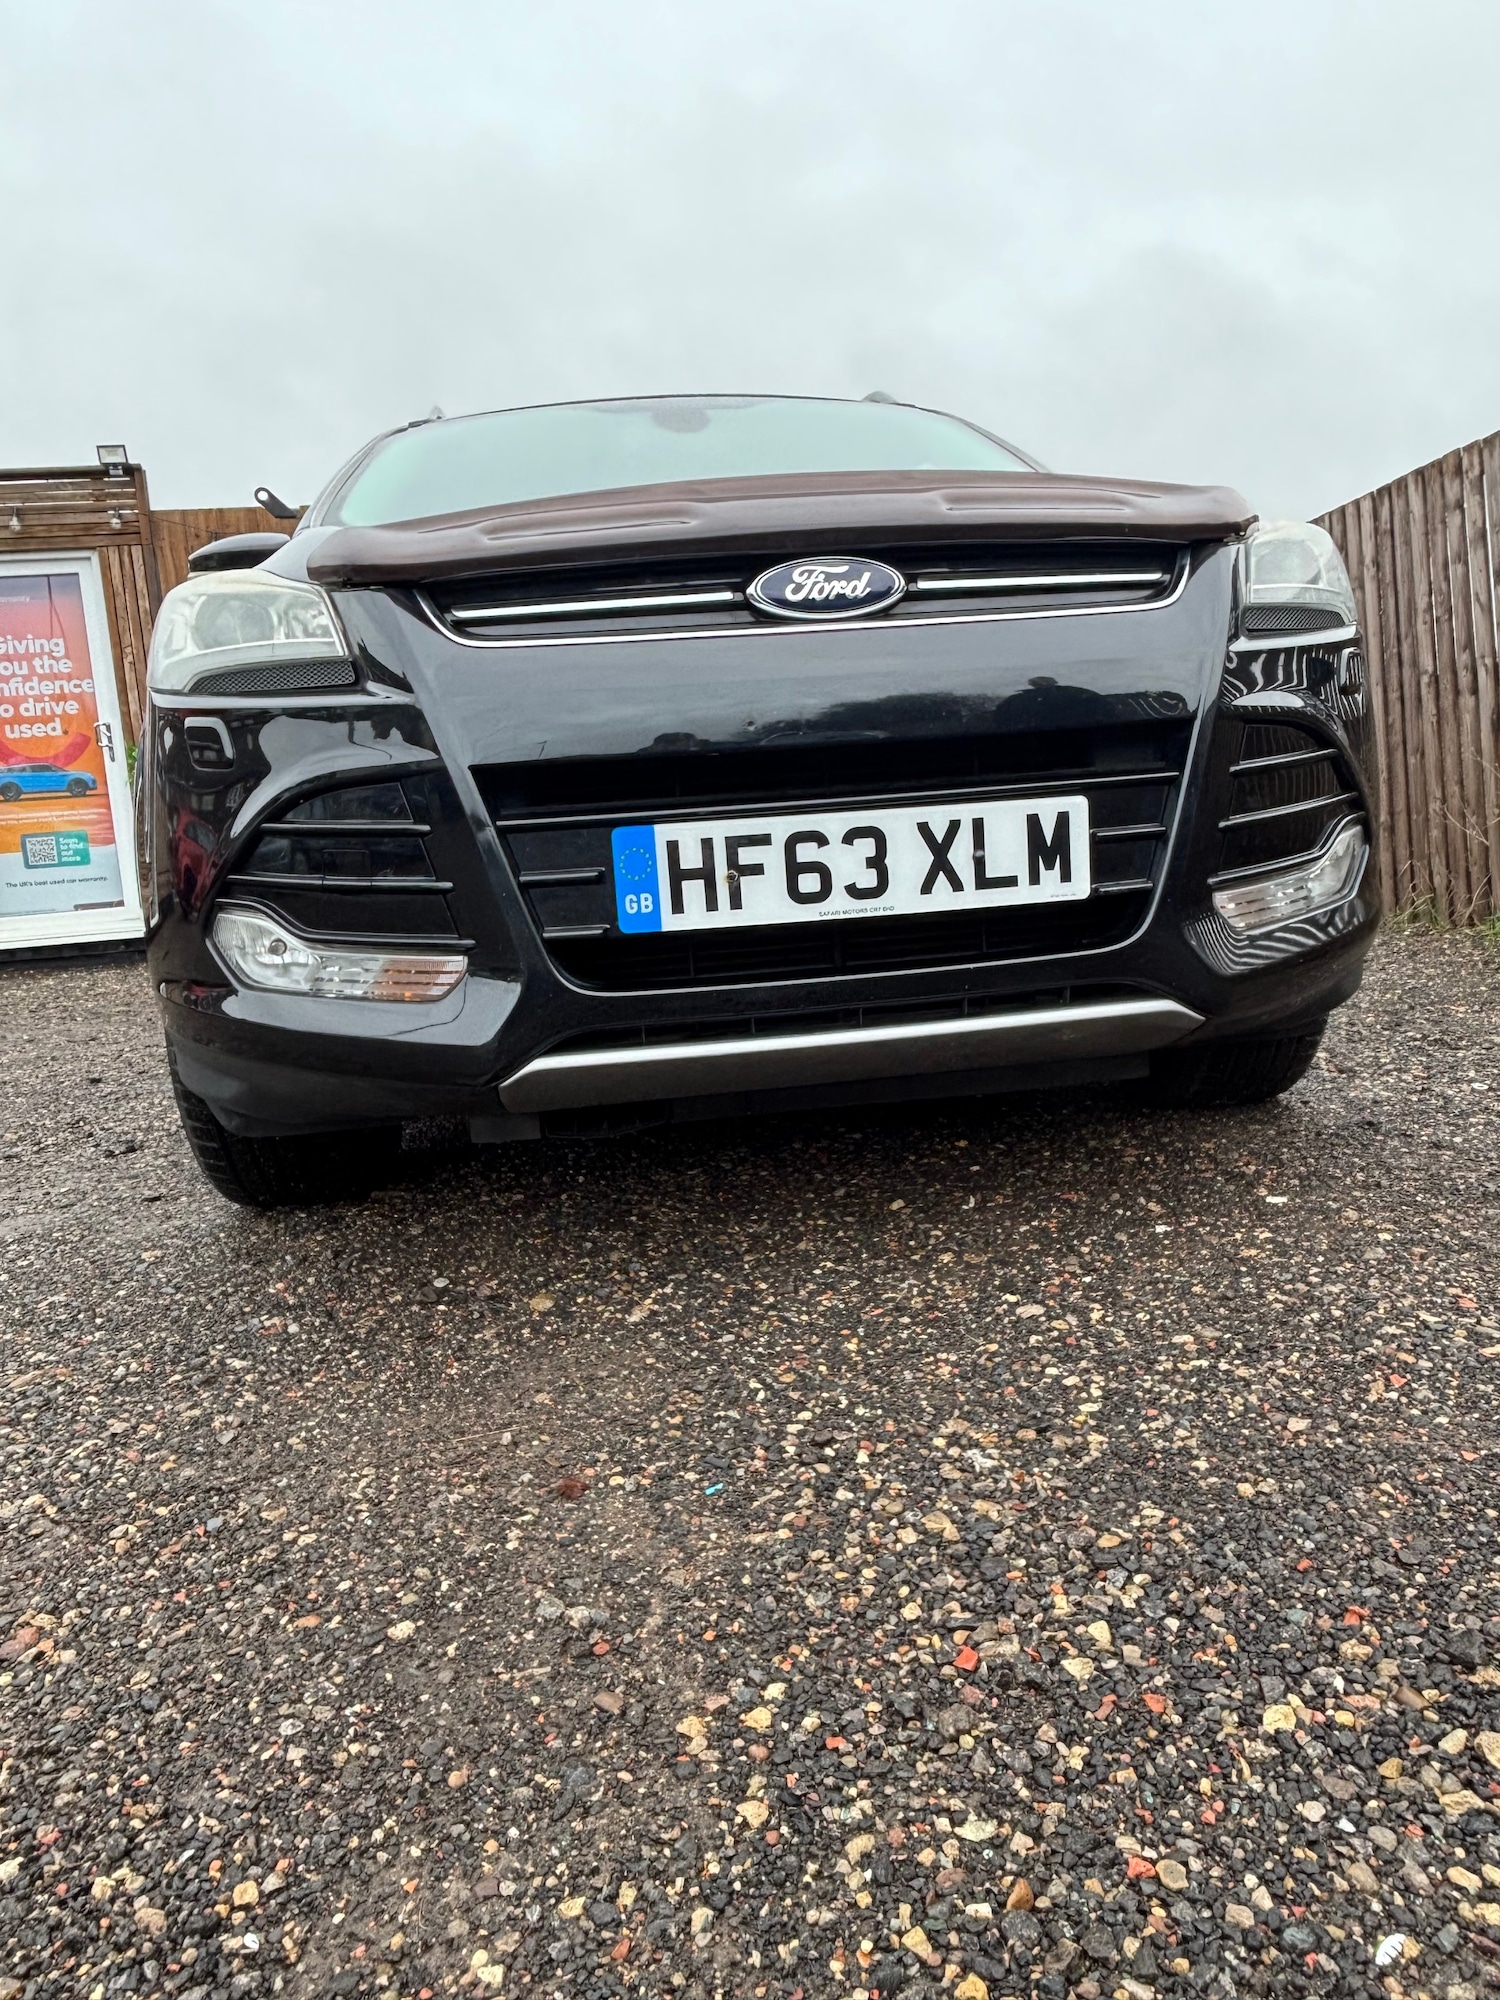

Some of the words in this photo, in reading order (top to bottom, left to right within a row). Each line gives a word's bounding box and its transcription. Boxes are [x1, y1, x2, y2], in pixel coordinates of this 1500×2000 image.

[785, 565, 872, 603] Ford
[0, 660, 28, 675] ou
[32, 655, 73, 674] the
[0, 676, 94, 696] nfidence
[0, 704, 14, 718] o
[19, 696, 79, 716] drive
[666, 825, 890, 915] HF63
[916, 811, 1072, 895] XLM
[624, 892, 654, 915] GB
[842, 907, 868, 915] MOTORS
